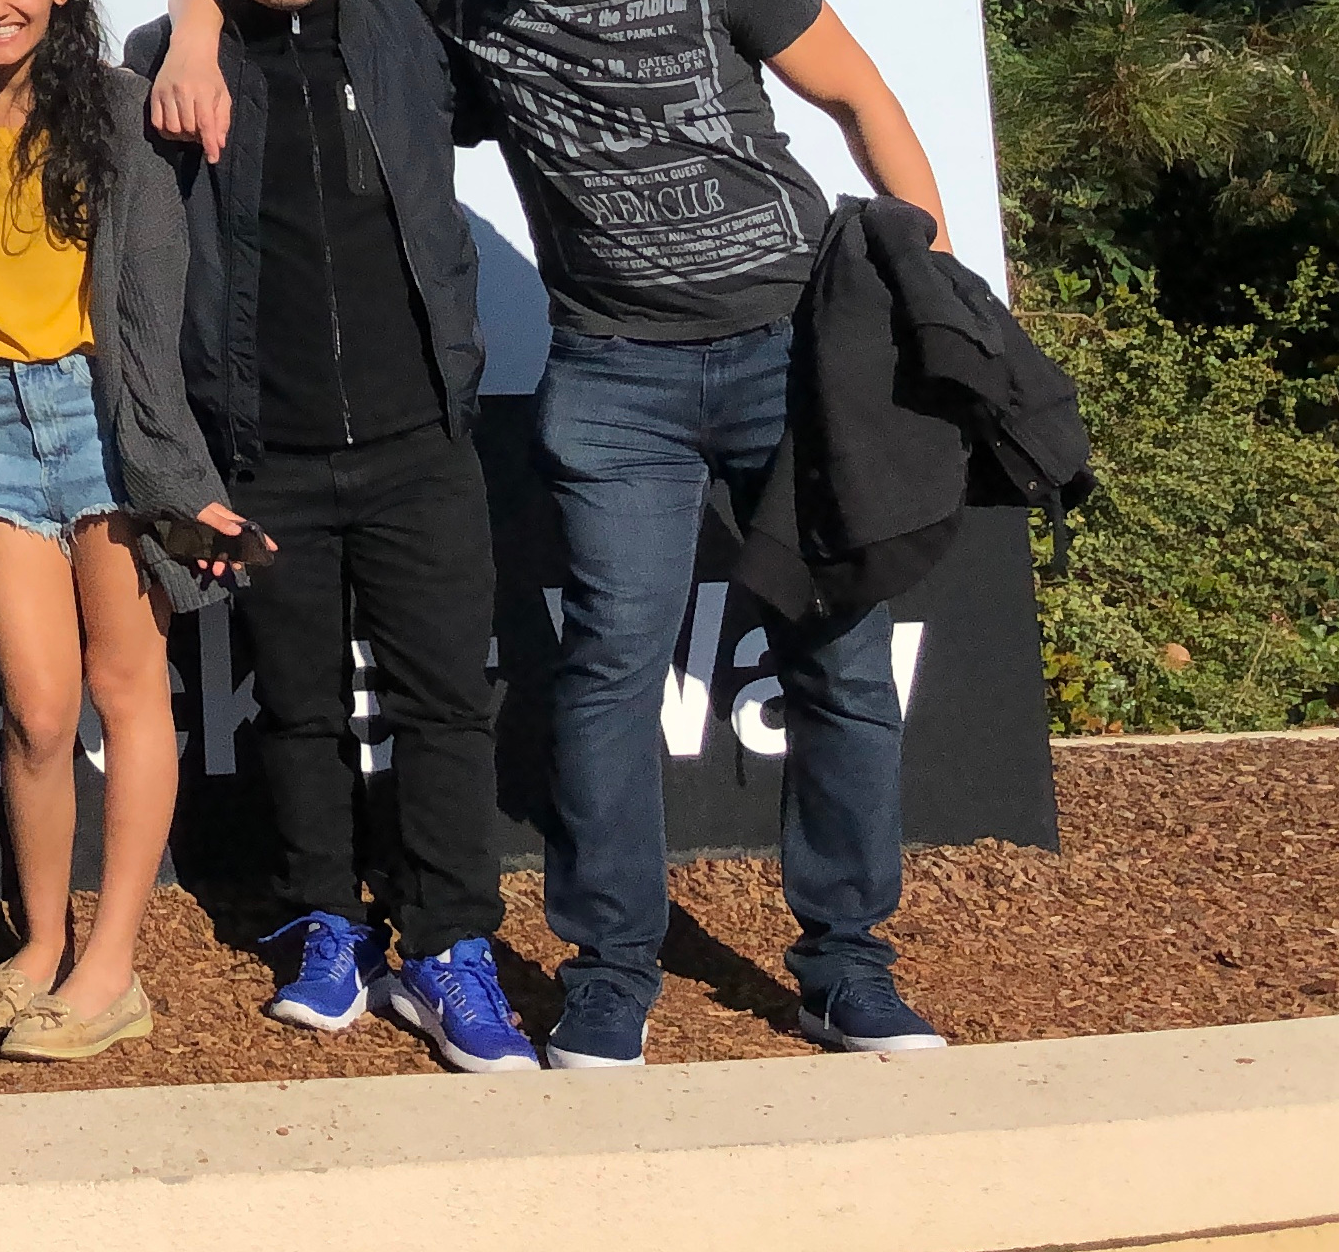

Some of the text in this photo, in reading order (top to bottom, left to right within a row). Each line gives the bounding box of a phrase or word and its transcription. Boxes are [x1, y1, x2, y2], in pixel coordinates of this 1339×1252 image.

[638, 47, 707, 69] GATES OPEN
[636, 68, 651, 79] AT
[623, 170, 669, 186] SPECIAL
[669, 163, 708, 180] GUEST:
[578, 177, 725, 226] SALEM CLUB
